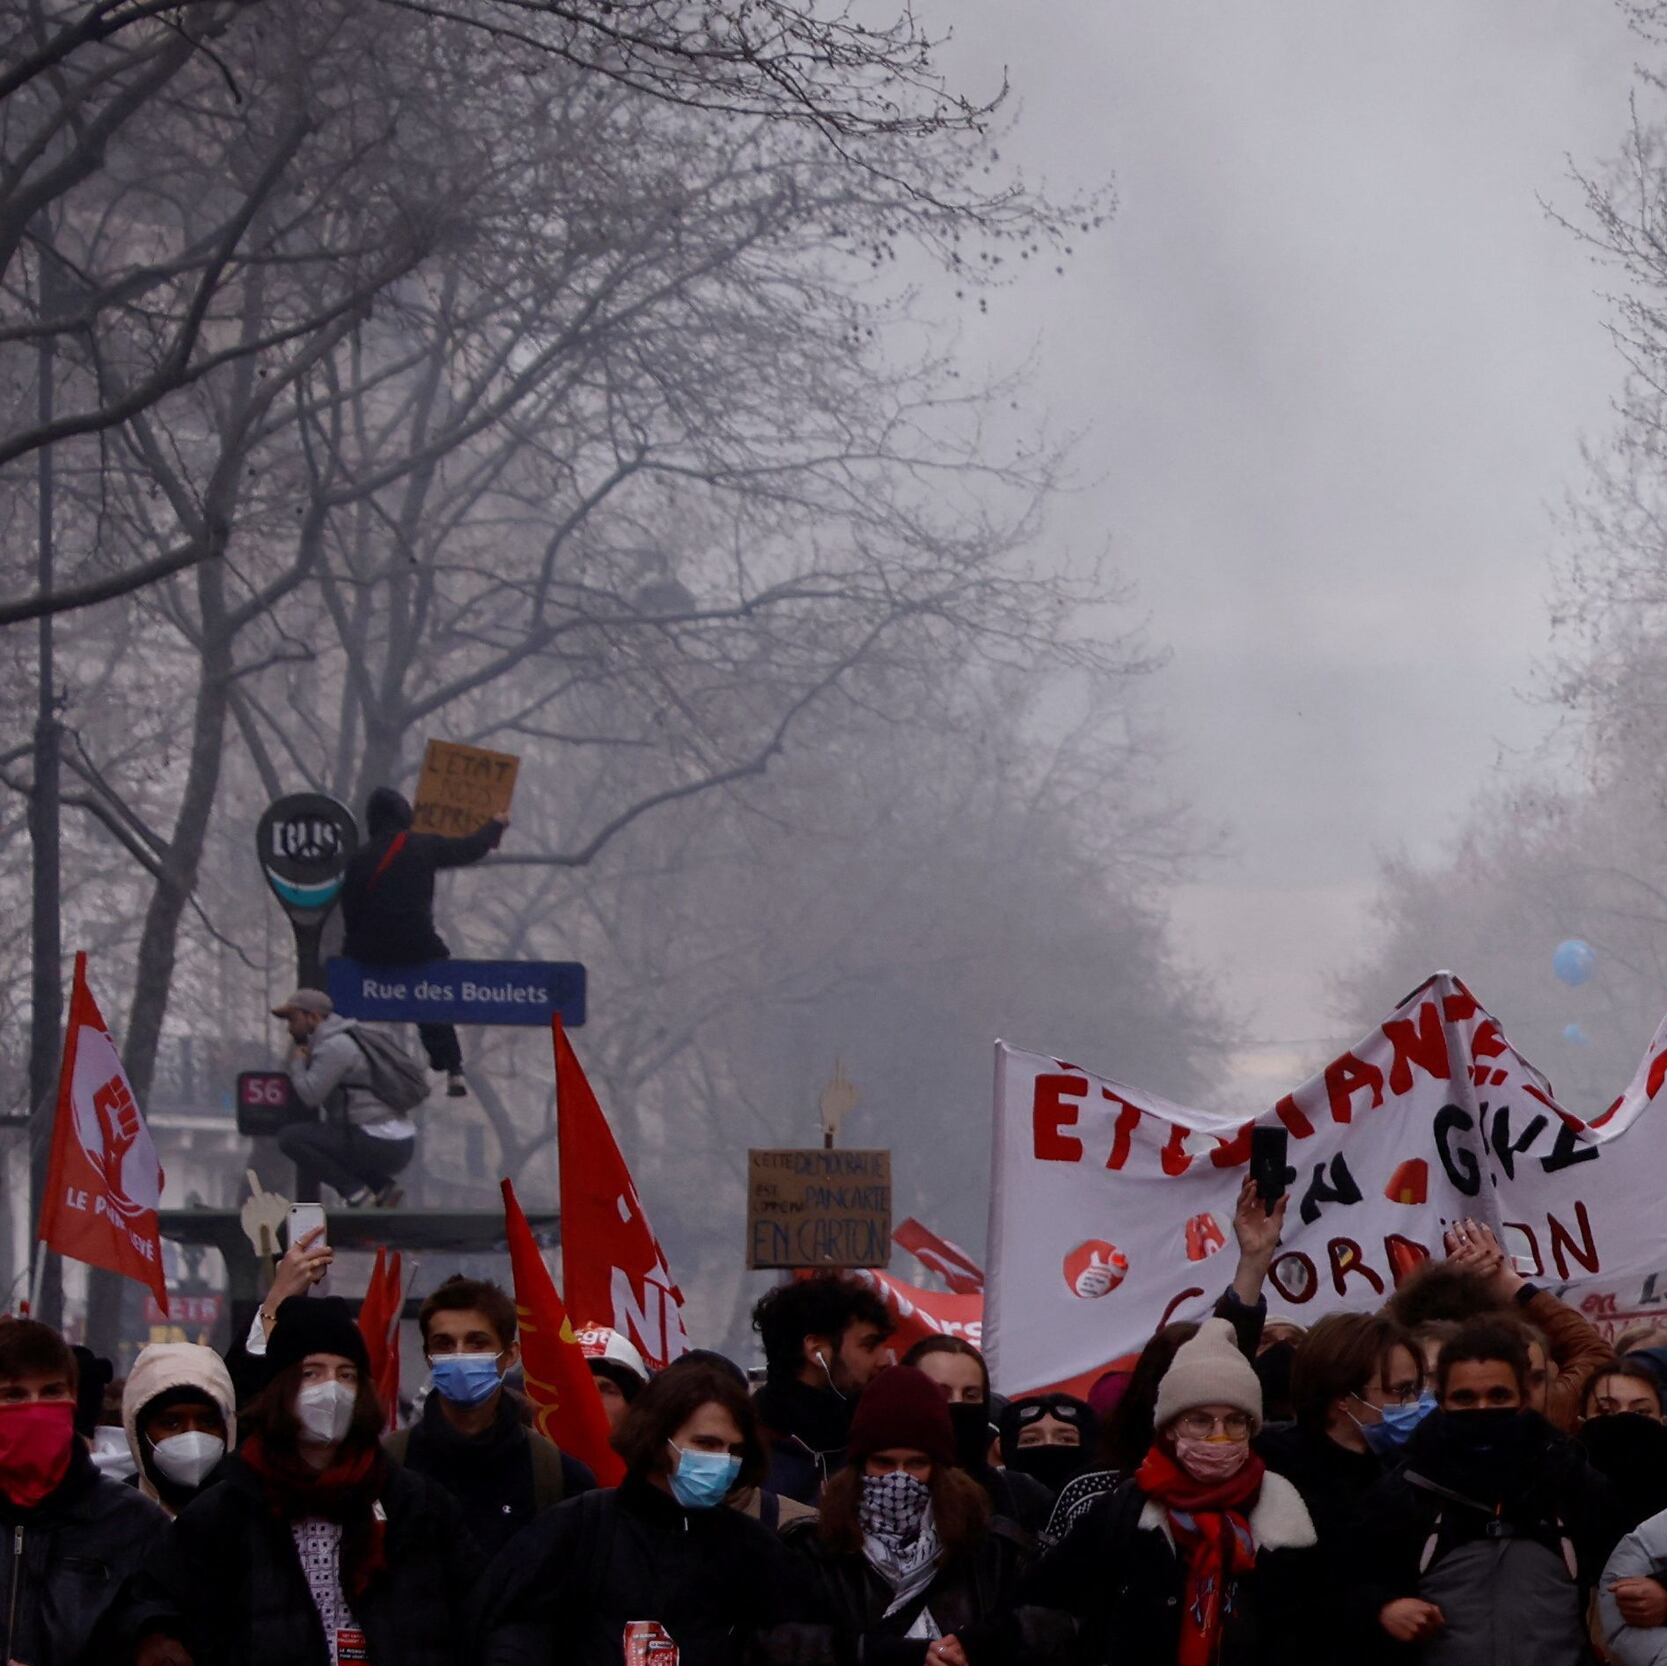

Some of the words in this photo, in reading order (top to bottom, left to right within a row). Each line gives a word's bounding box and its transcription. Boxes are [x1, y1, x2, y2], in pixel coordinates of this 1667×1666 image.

[363, 979, 407, 999] Rue
[414, 980, 453, 1000] des
[462, 982, 548, 1004] Boulets
[248, 1079, 282, 1104] 56
[66, 1187, 88, 1211] LE
[754, 1219, 790, 1263] EN
[798, 1218, 889, 1262] CARTON
